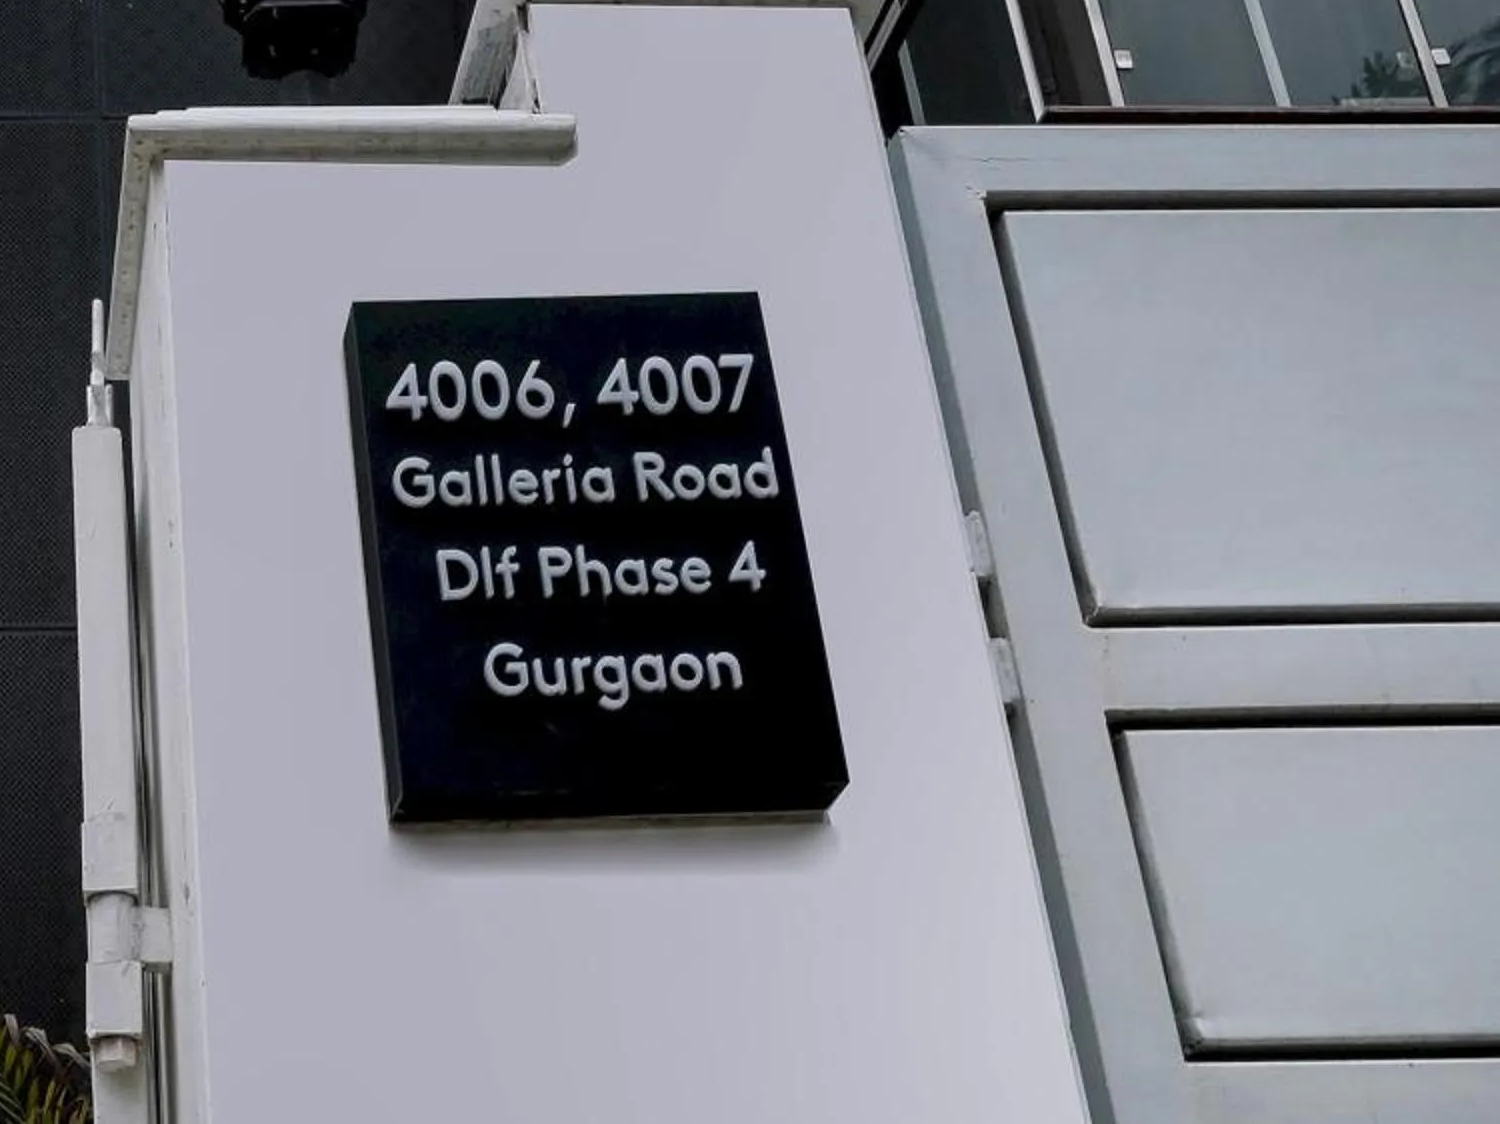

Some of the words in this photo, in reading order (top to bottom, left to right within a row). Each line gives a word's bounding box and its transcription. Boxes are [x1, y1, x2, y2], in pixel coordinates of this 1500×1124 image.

[386, 359, 576, 428] 4006,
[597, 354, 754, 415] 4007
[392, 453, 615, 508] Galleria
[633, 446, 779, 502] Road
[436, 545, 520, 601] Dlf
[538, 544, 712, 599] Phase
[729, 540, 767, 592] 4
[484, 642, 743, 711] Gurgaon
